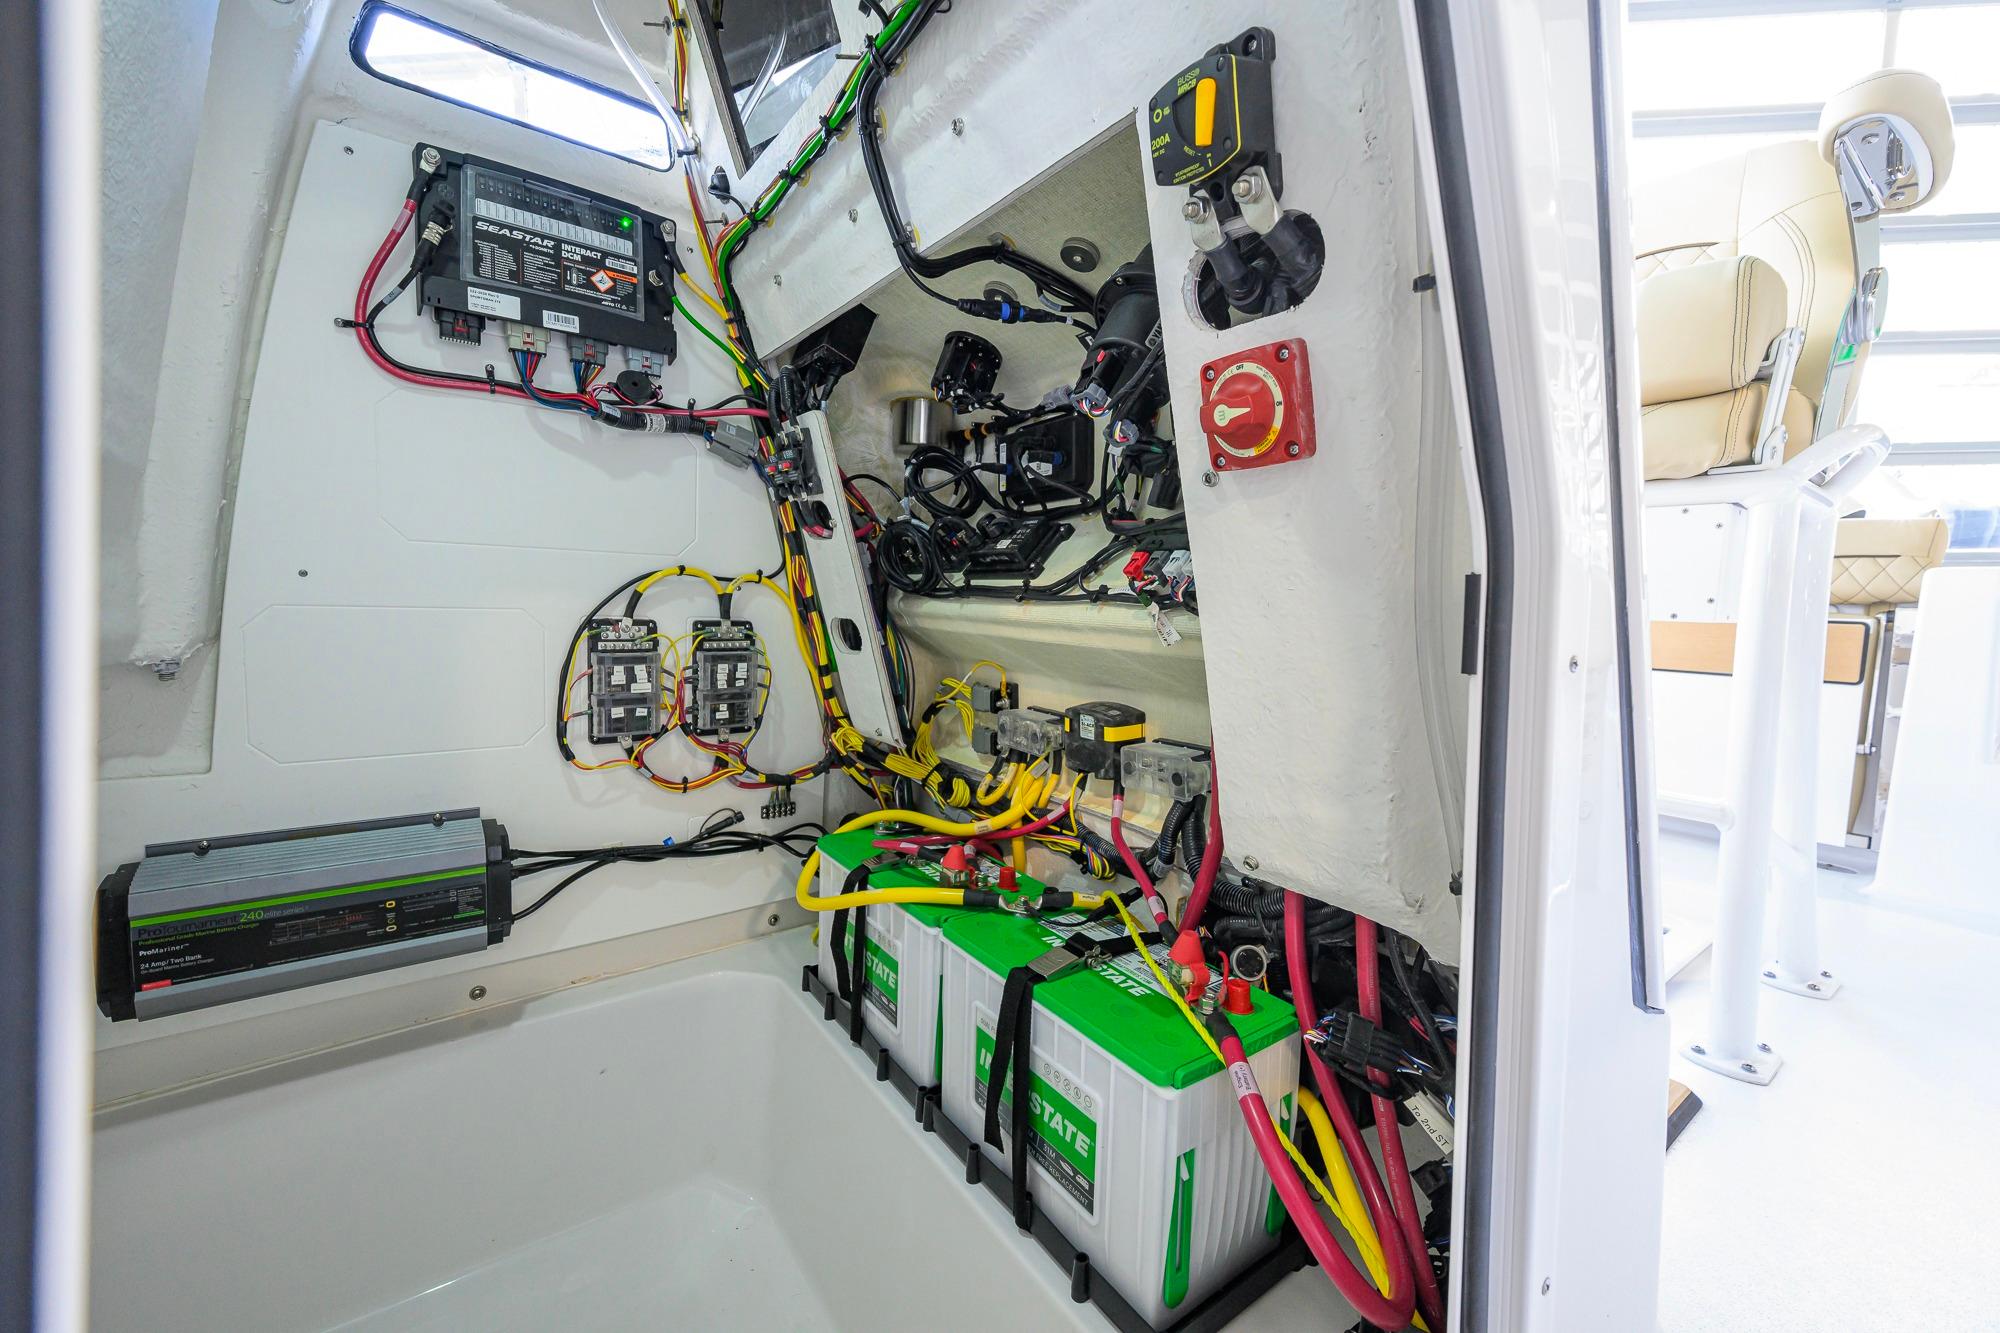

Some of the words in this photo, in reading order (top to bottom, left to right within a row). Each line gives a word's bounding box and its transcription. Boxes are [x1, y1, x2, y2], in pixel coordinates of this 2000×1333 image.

[1178, 78, 1197, 96] MRCB
[1151, 132, 1171, 151] 200A
[475, 220, 556, 249] SEASTAR
[561, 242, 602, 260] INTERACT
[561, 250, 582, 262] DCM
[137, 914, 241, 939] ProTournament
[240, 910, 264, 922] 240
[195, 929, 216, 938] Marine
[140, 962, 150, 970] 24
[185, 953, 202, 961] Bank
[1411, 1104, 1421, 1117] To
[1420, 1118, 1438, 1135] 2nd
[1435, 1134, 1450, 1147] ST
[1049, 1167, 1089, 1207] REPLACEMENT
